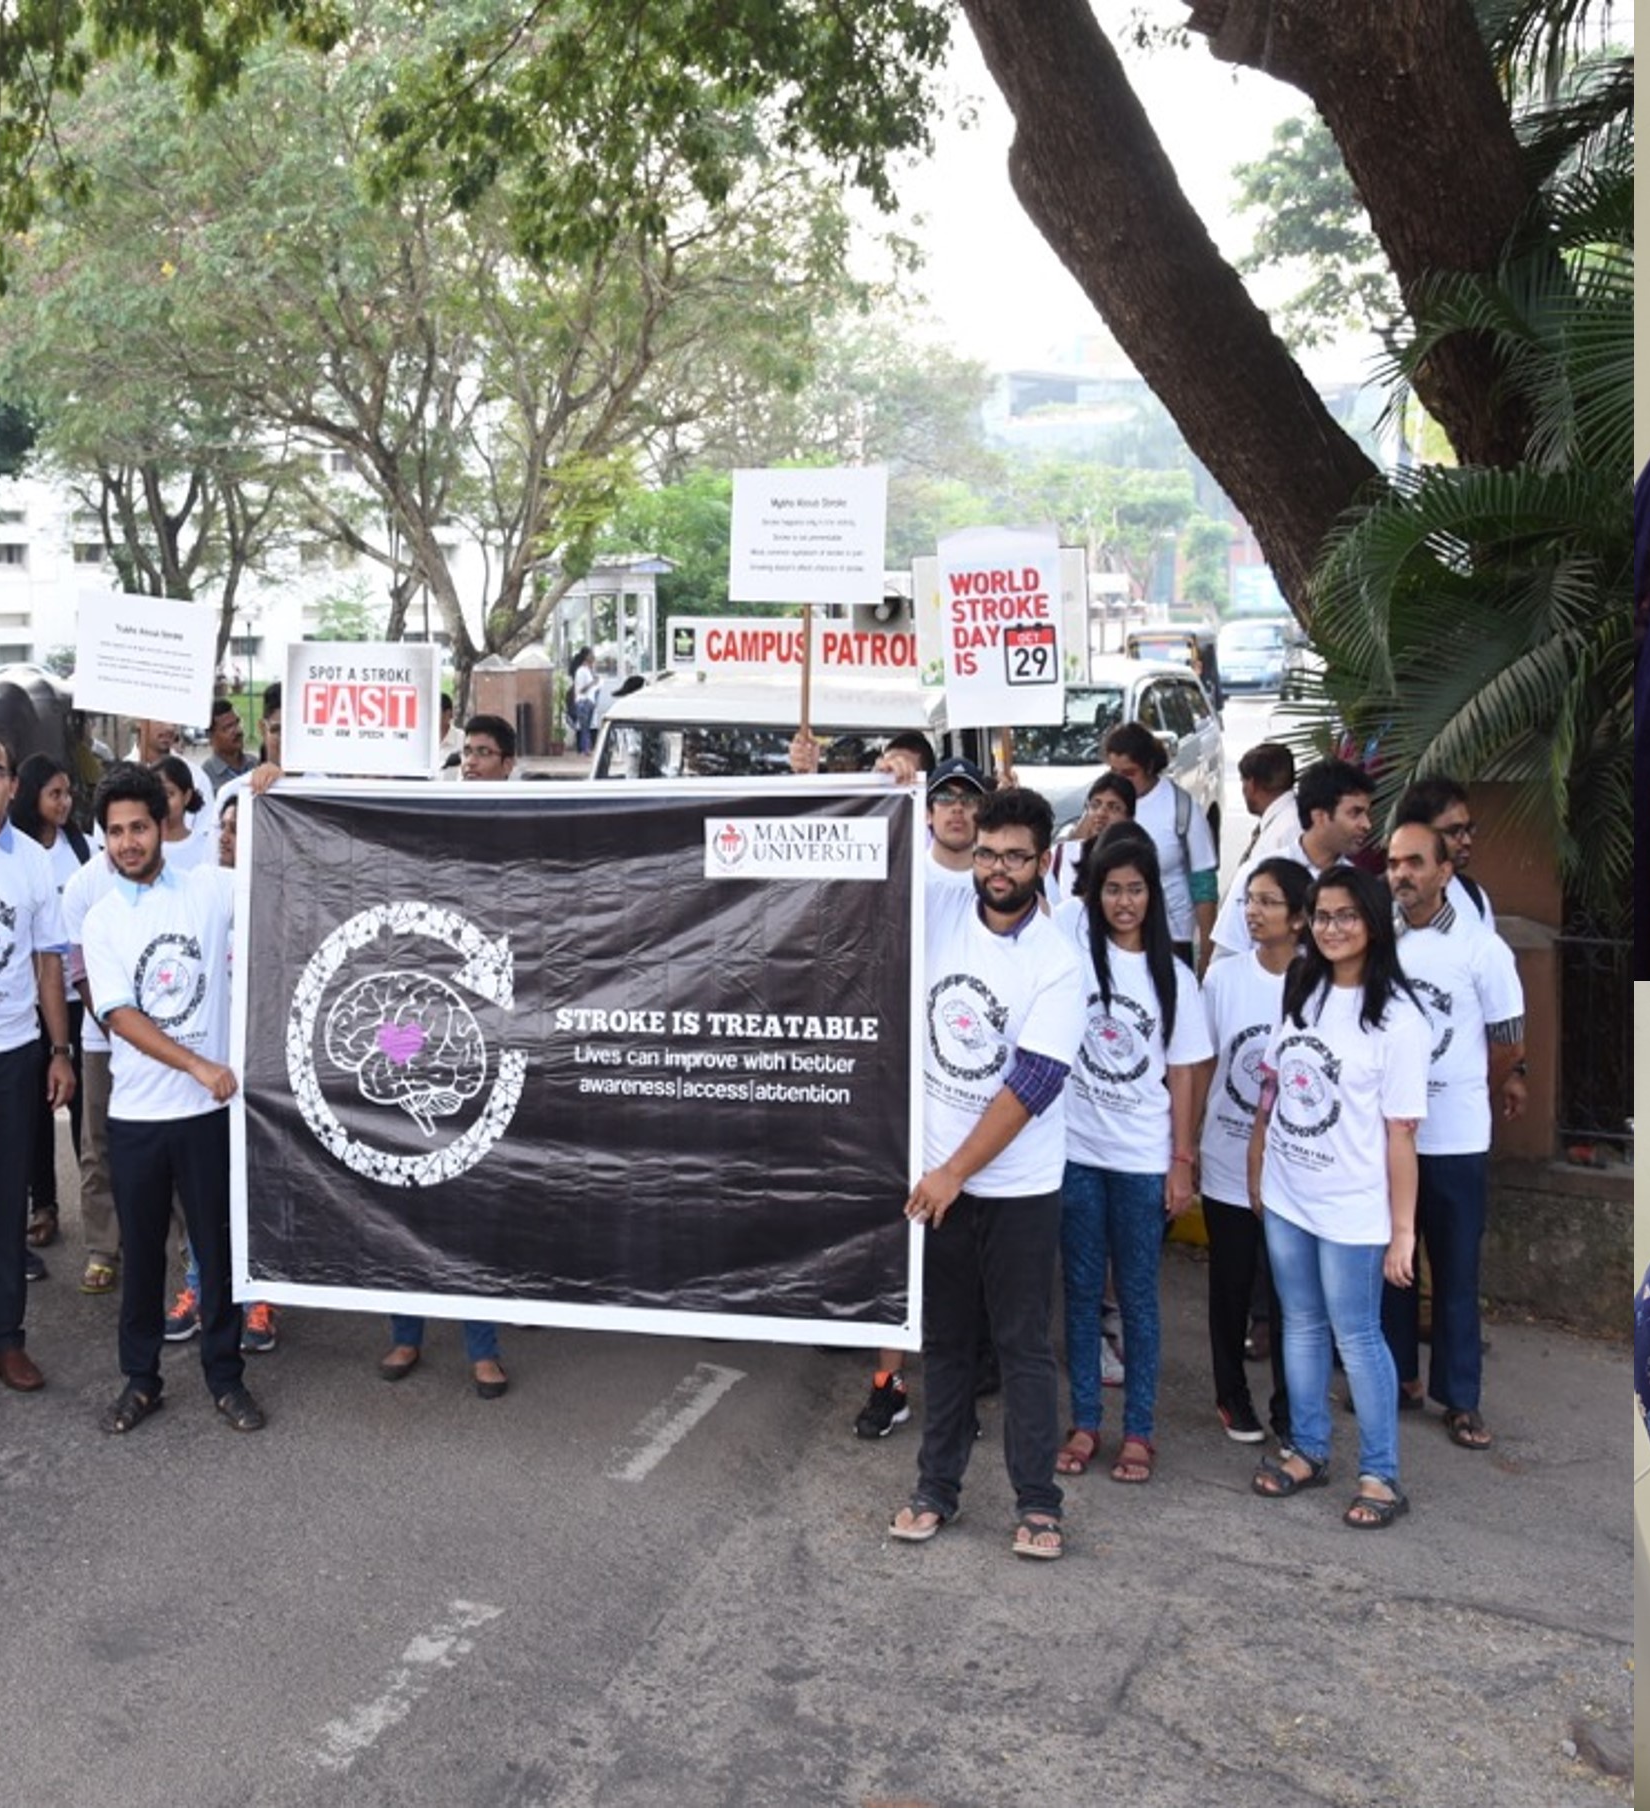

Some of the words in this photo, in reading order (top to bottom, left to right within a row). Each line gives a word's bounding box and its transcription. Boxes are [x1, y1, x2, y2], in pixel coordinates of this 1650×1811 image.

[949, 567, 1040, 596] WORLD
[951, 594, 1050, 624] STROKE
[706, 629, 805, 665] CAMPUS
[823, 631, 918, 667] PATROL
[953, 625, 1001, 650] DAY
[1015, 631, 1041, 645] OCT
[309, 666, 342, 680] SPOT
[347, 667, 357, 680] A
[361, 667, 411, 683] STROKE
[954, 652, 979, 677] IS
[1013, 647, 1048, 678] 29
[306, 686, 416, 728] FAST
[752, 822, 853, 842] MANIPAL
[752, 842, 884, 863] UNIVERSITY
[555, 1008, 666, 1035] STROKE
[672, 1011, 700, 1035] IS
[707, 1014, 879, 1041] TREATABLE
[574, 1045, 622, 1066] Lives
[626, 1050, 660, 1067] can
[664, 1049, 738, 1072] improve
[743, 1052, 787, 1072] with
[791, 1052, 856, 1073] better
